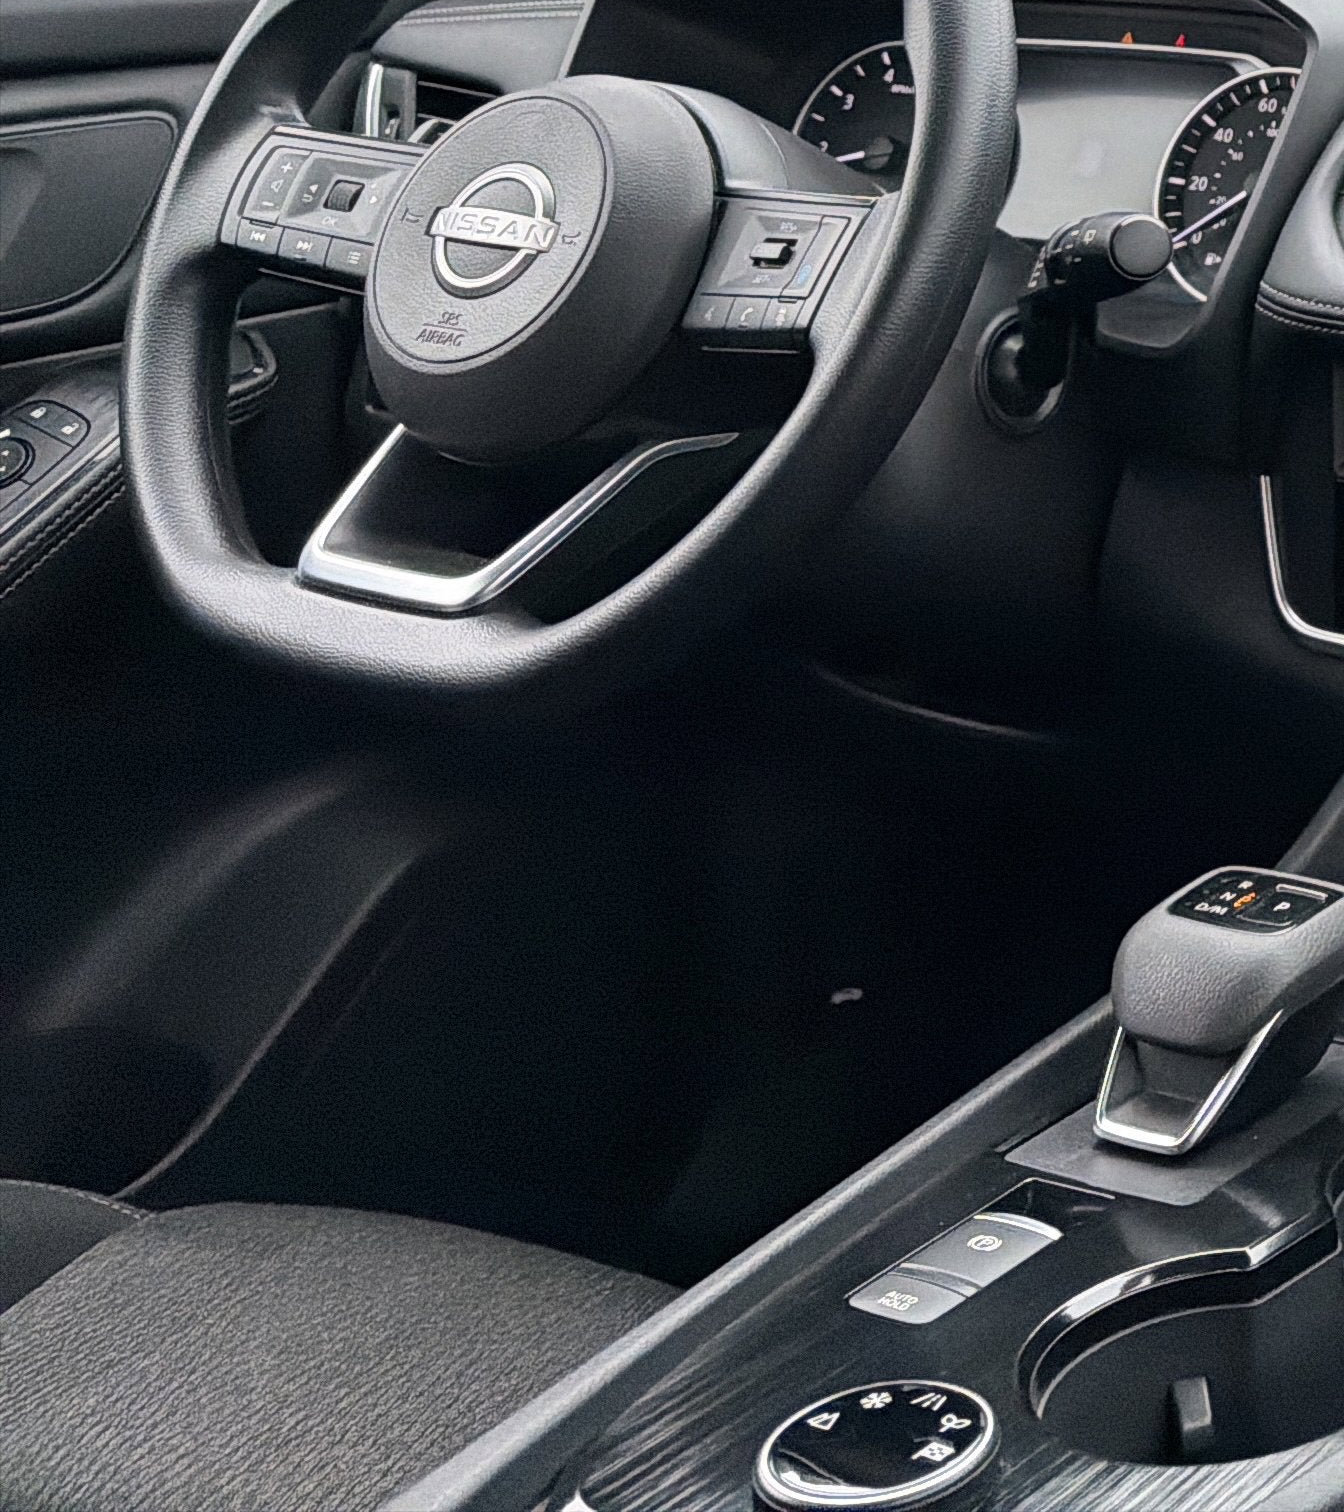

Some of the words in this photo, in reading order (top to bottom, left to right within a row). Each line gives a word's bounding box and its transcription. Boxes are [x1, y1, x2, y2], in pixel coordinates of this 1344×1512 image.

[882, 68, 895, 82] 4
[842, 93, 854, 110] 3
[1257, 97, 1278, 113] 60
[1214, 127, 1234, 143] 40
[1188, 175, 1208, 191] 20
[431, 210, 555, 249] NISSAN
[416, 328, 465, 347] AIRBAG
[1238, 880, 1254, 889] R
[1220, 891, 1236, 901] N
[1193, 902, 1230, 915] D/M
[1273, 901, 1291, 912] P
[877, 1297, 911, 1311] HOLD
[885, 1290, 919, 1305] AUTO
